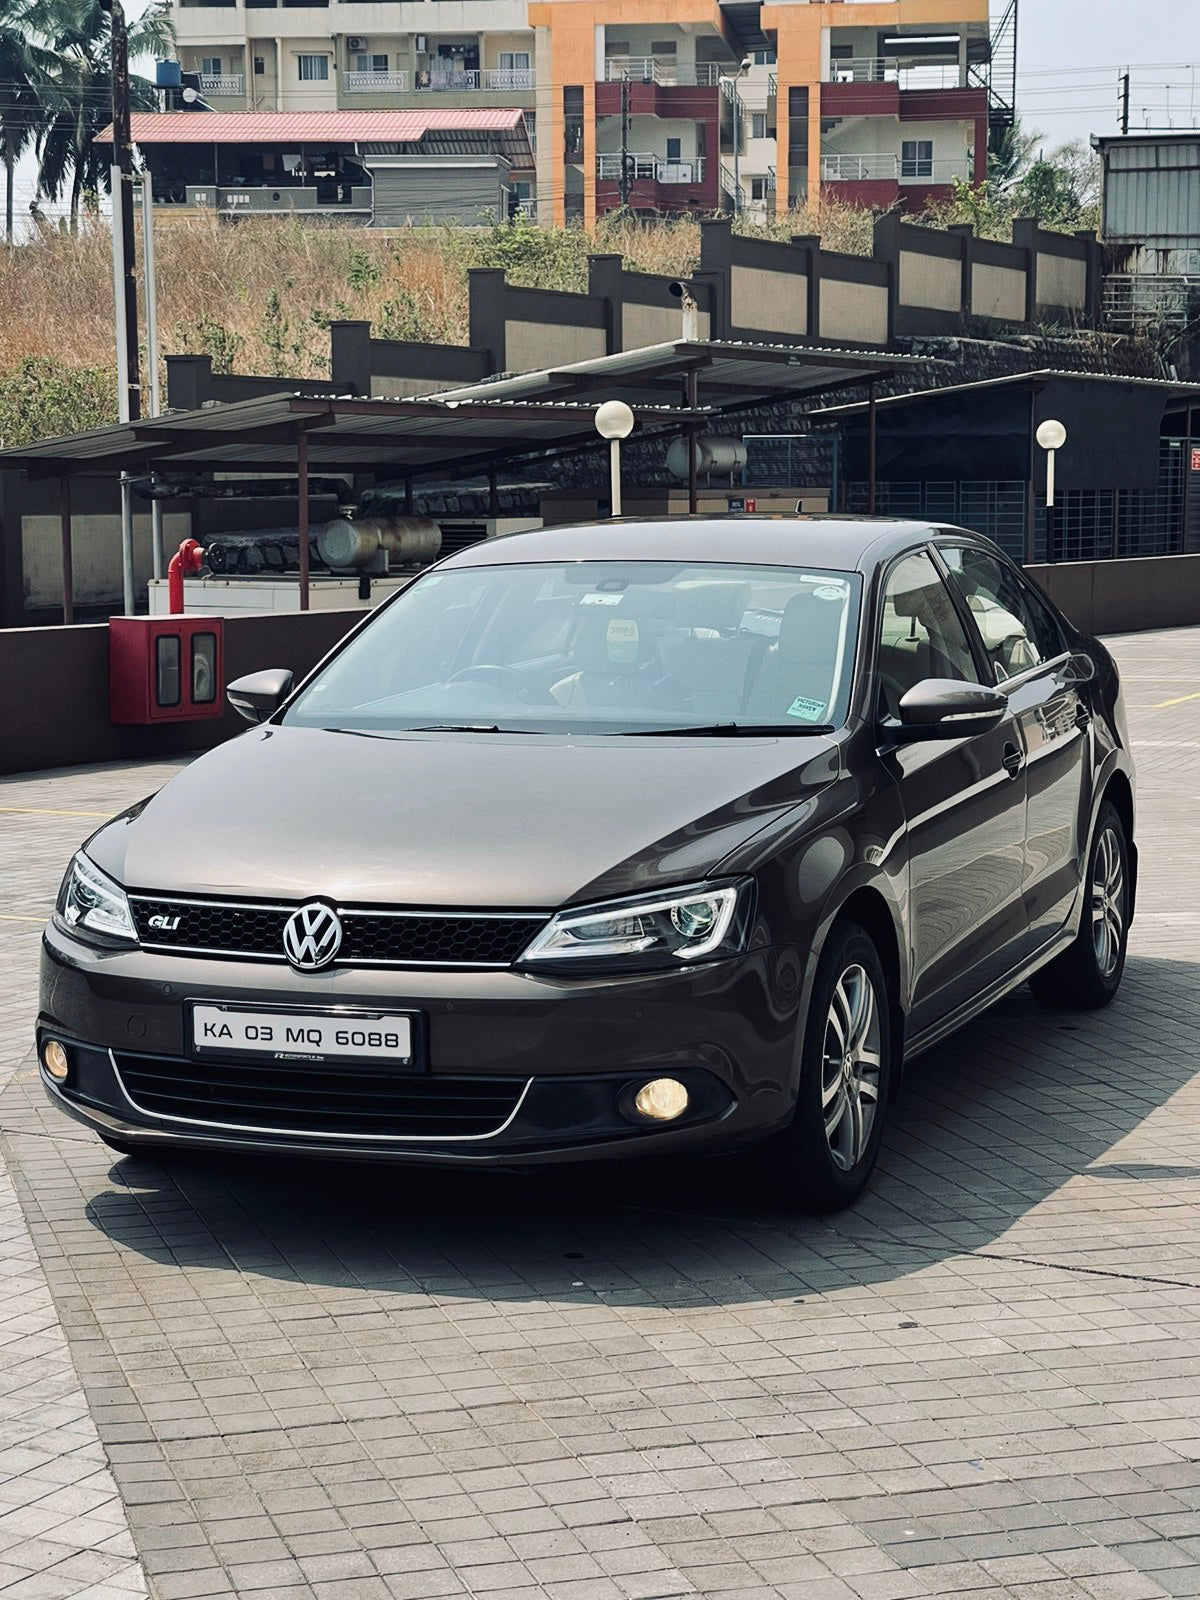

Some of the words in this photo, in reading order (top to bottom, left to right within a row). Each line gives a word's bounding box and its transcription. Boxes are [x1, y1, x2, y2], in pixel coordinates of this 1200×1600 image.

[148, 915, 181, 930] GLI
[203, 1022, 233, 1039] KA
[244, 1025, 273, 1041] 03
[286, 1027, 322, 1047] MQ
[335, 1030, 399, 1048] 6088
